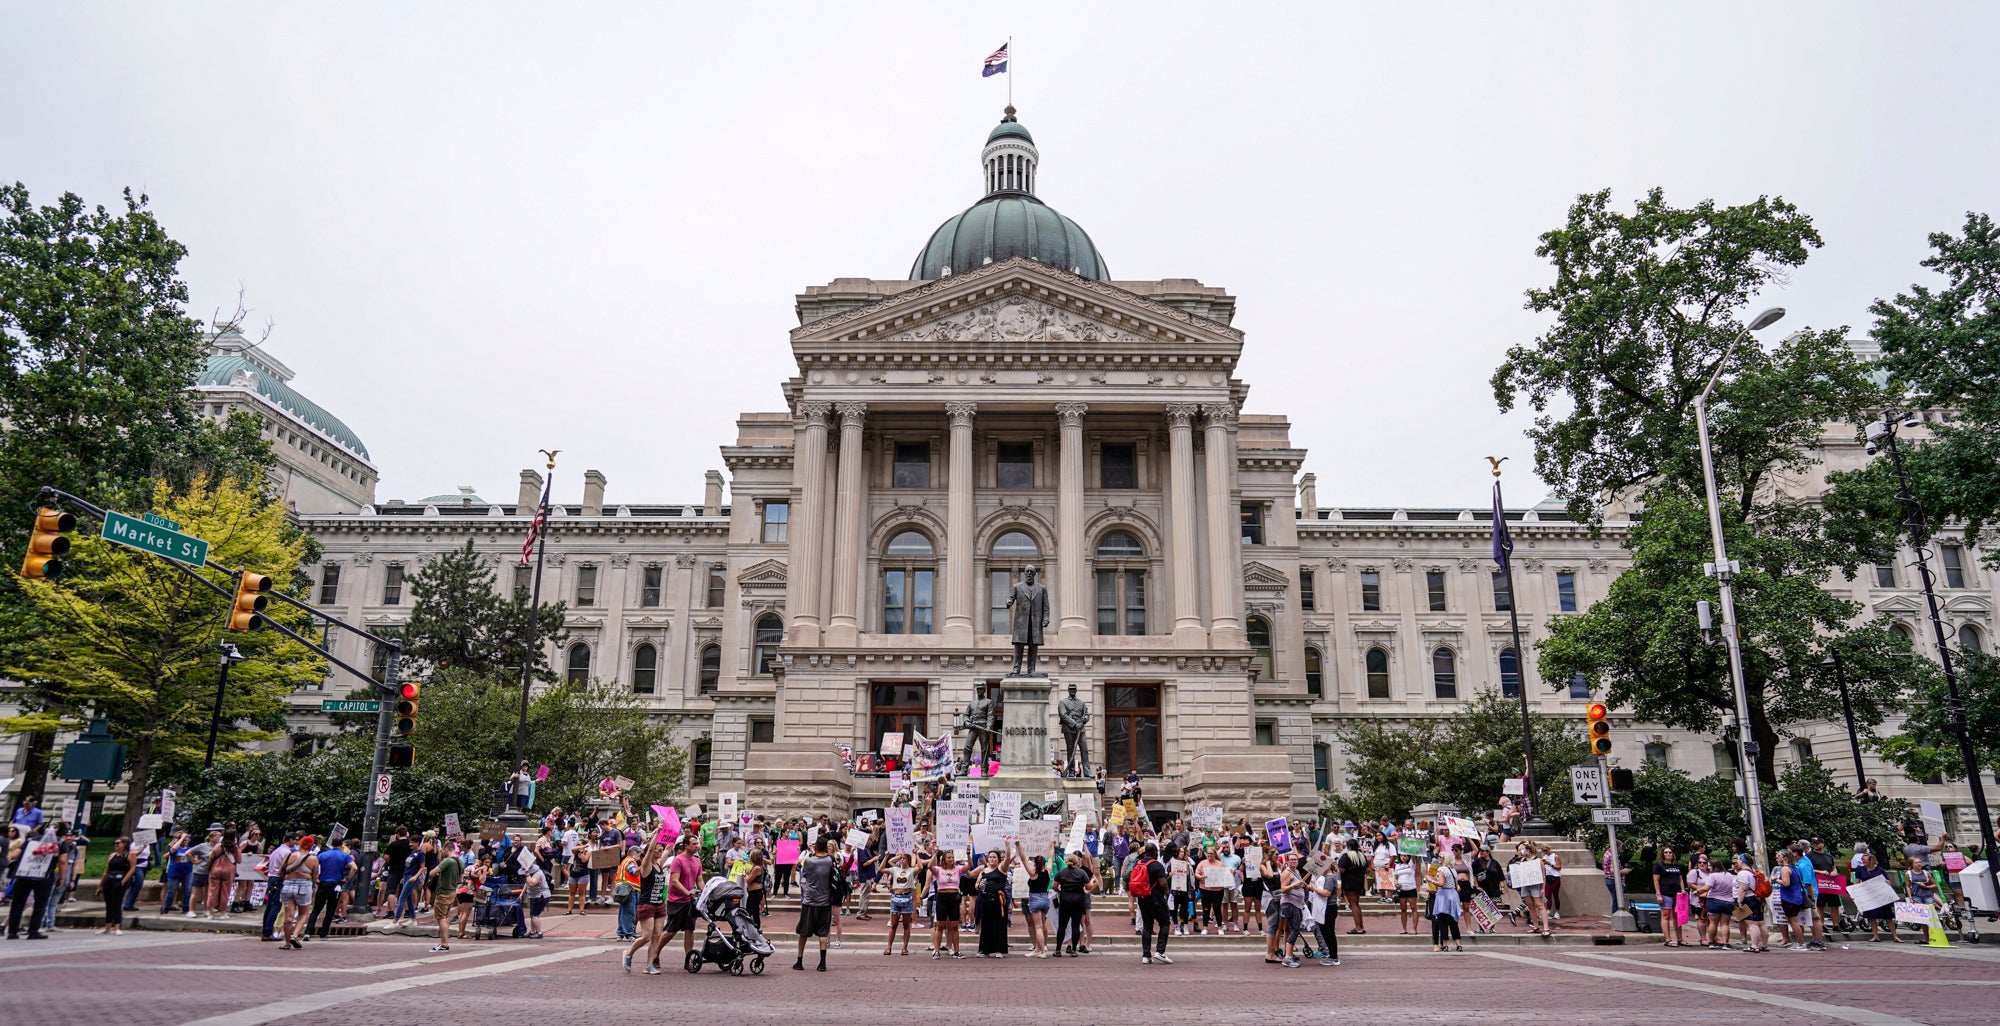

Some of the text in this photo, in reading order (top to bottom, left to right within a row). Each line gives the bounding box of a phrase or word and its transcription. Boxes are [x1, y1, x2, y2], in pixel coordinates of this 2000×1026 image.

[150, 516, 164, 527] 100
[113, 520, 198, 559] Market St
[339, 702, 369, 711] CAPITOL
[1004, 727, 1048, 736] MORTON
[1575, 770, 1597, 779] ONE
[1575, 782, 1599, 791] WAY
[988, 818, 1014, 826] MATERNAL
[1896, 906, 1929, 914] ASSAULT
